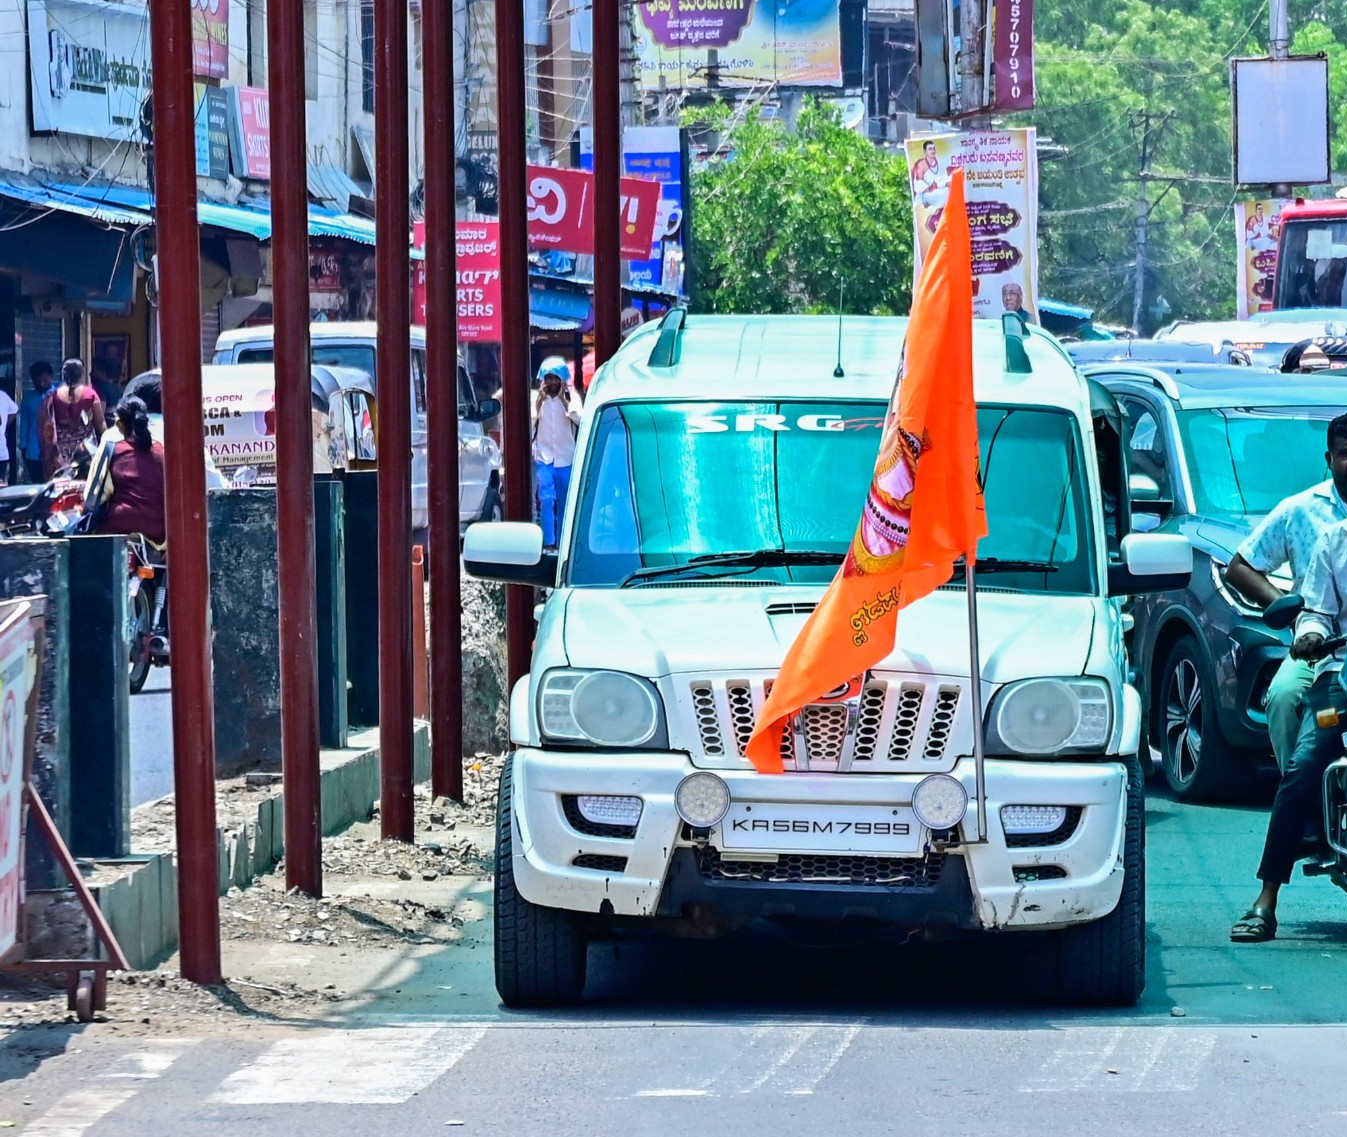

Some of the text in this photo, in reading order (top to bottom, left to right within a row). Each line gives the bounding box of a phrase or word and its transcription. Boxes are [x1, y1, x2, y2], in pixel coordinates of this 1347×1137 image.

[215, 394, 243, 404] OPEN
[686, 414, 845, 434] SRG
[223, 454, 274, 464] Management
[731, 818, 911, 837] KA56M7999
